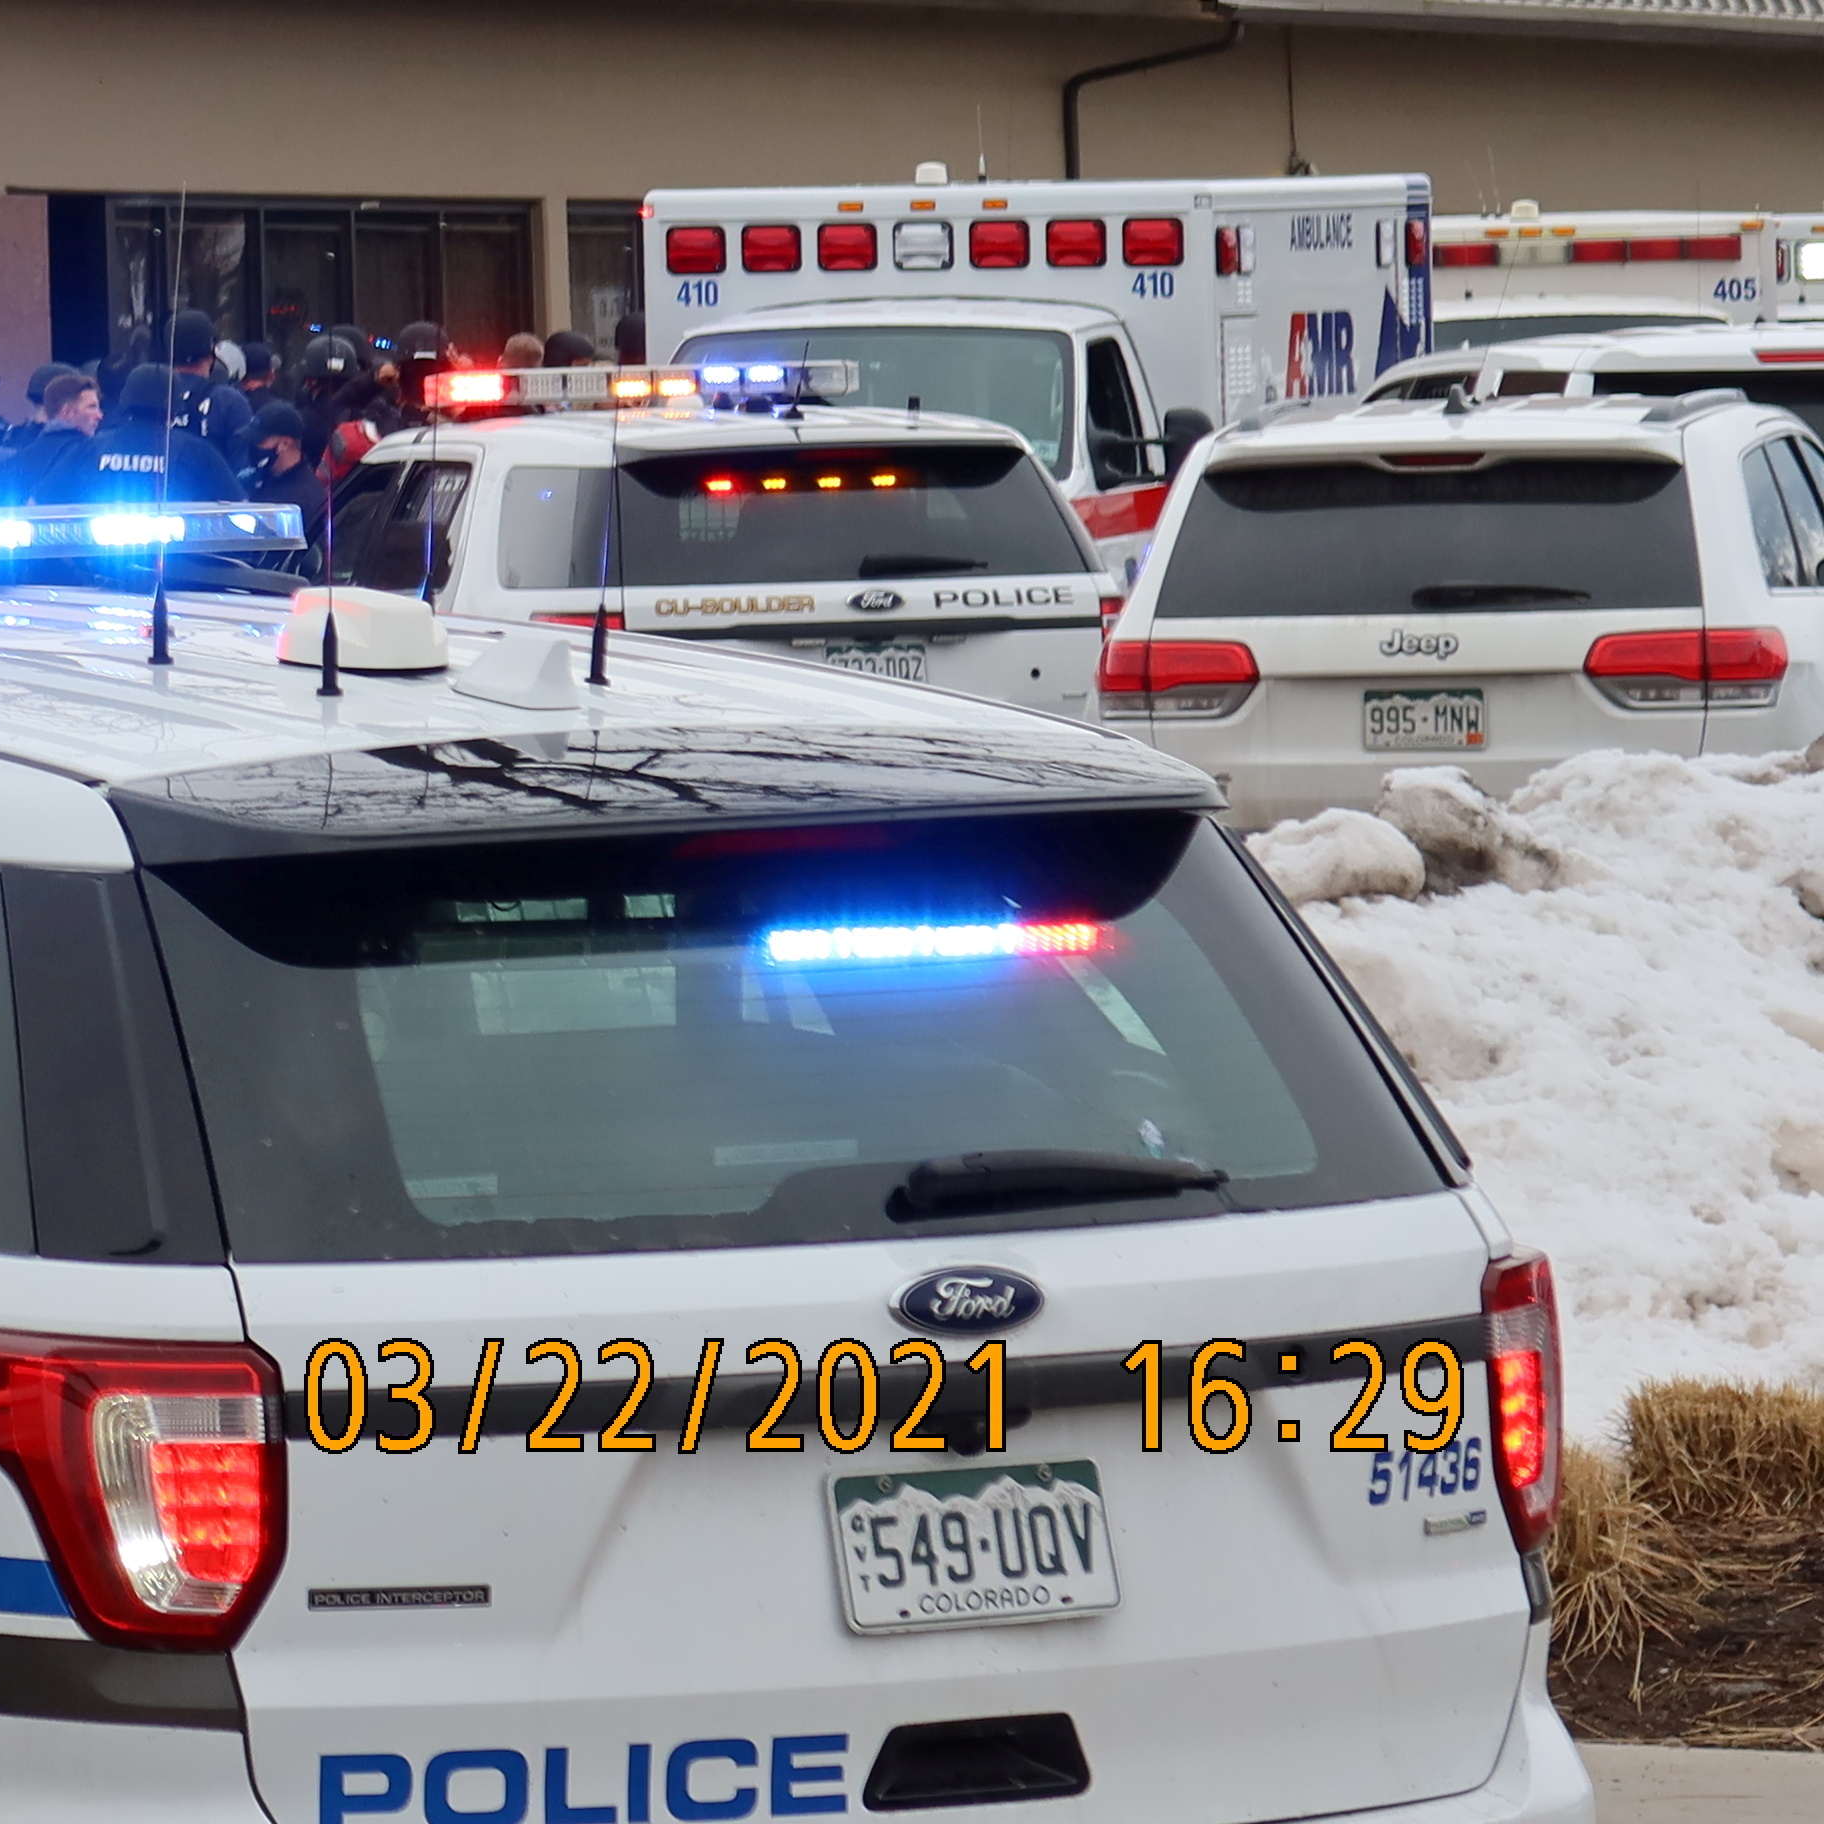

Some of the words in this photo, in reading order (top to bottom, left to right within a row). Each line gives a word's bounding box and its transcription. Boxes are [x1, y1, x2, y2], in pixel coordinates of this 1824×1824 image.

[1290, 211, 1353, 252] AMBULANCE
[677, 278, 719, 307] 410
[1131, 271, 1174, 299] 410
[1713, 278, 1757, 303] 405
[1285, 309, 1356, 398] AMR
[98, 453, 166, 474] POLICE
[654, 594, 816, 617] CU-BOULDER
[933, 585, 1075, 610] POLICE
[1379, 628, 1459, 660] Jeep
[929, 1276, 1016, 1321] Ford
[1367, 1436, 1482, 1505] 51436
[313, 1592, 372, 1606] POLICE
[376, 1588, 486, 1604] INTERCEPTOR
[918, 1584, 1052, 1615] COLORADO
[318, 1733, 851, 1824] POLICE
